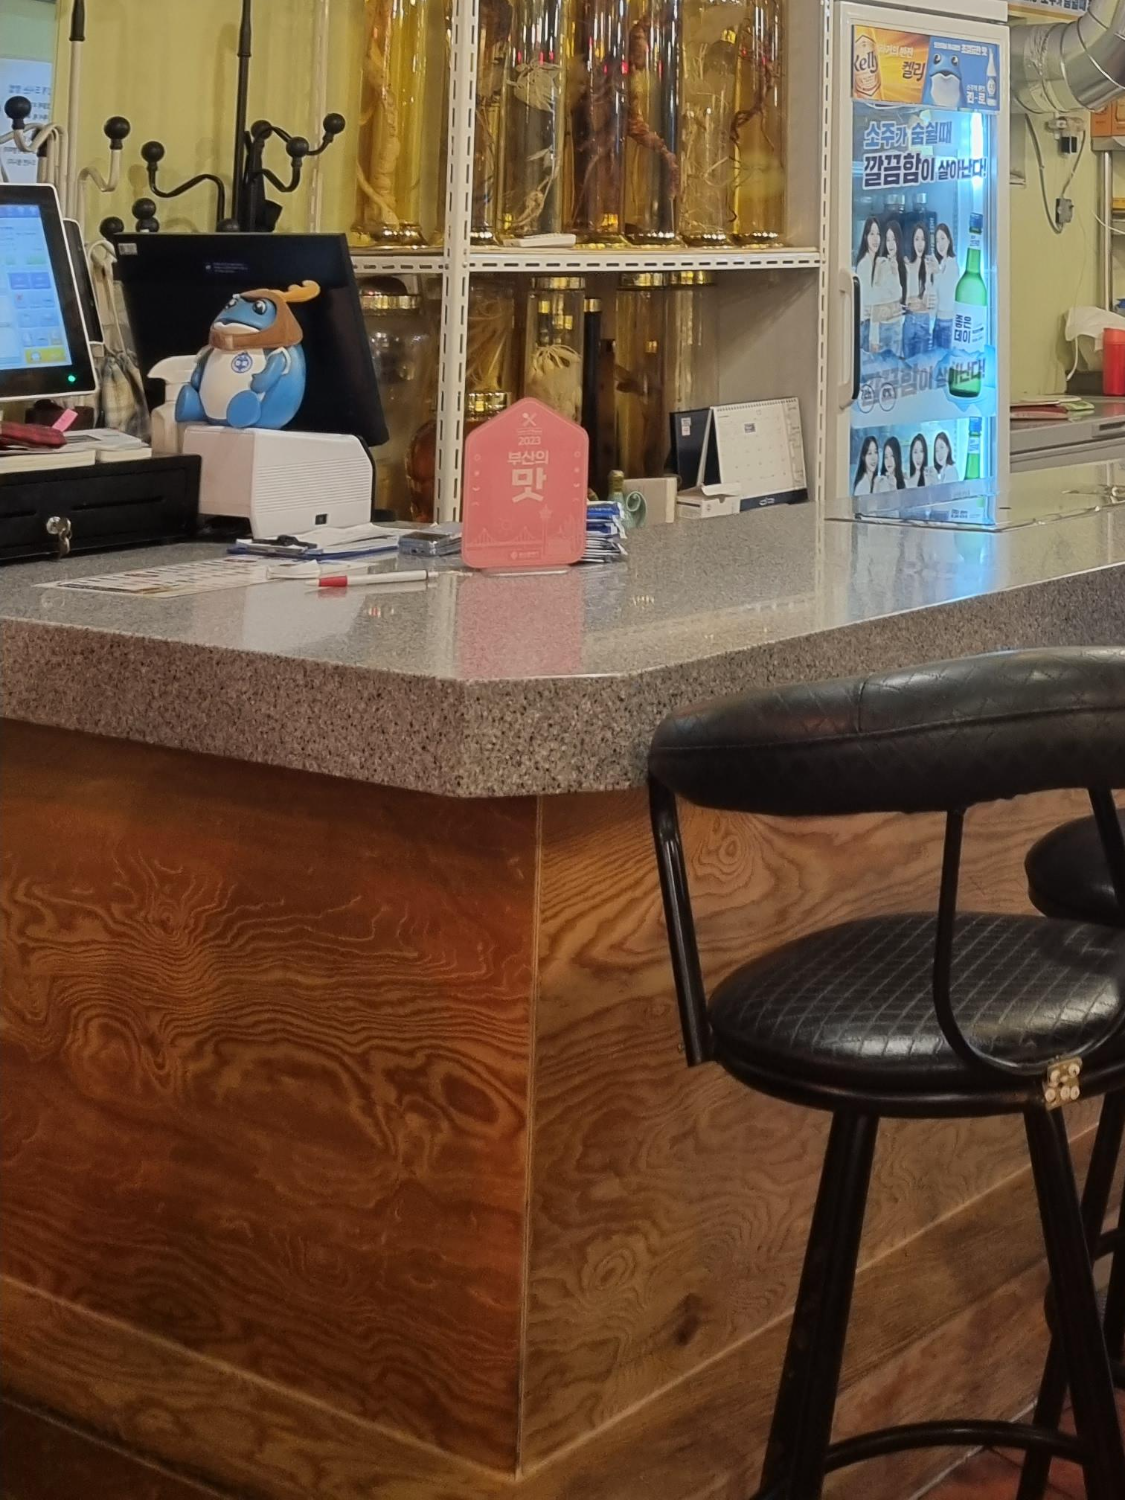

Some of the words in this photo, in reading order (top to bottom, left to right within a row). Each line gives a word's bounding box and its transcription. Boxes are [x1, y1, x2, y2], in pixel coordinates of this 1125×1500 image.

[902, 61, 925, 81] 켈리
[864, 121, 907, 148] 소주가
[911, 121, 952, 146] 숨쉴때
[864, 153, 936, 188] 깔끔함이
[938, 157, 987, 181] 살아난다!
[955, 314, 972, 329] 좋은
[954, 329, 971, 344] 데이
[517, 436, 541, 446] 2023
[507, 450, 549, 465] 부산의
[511, 467, 547, 503] 맛
